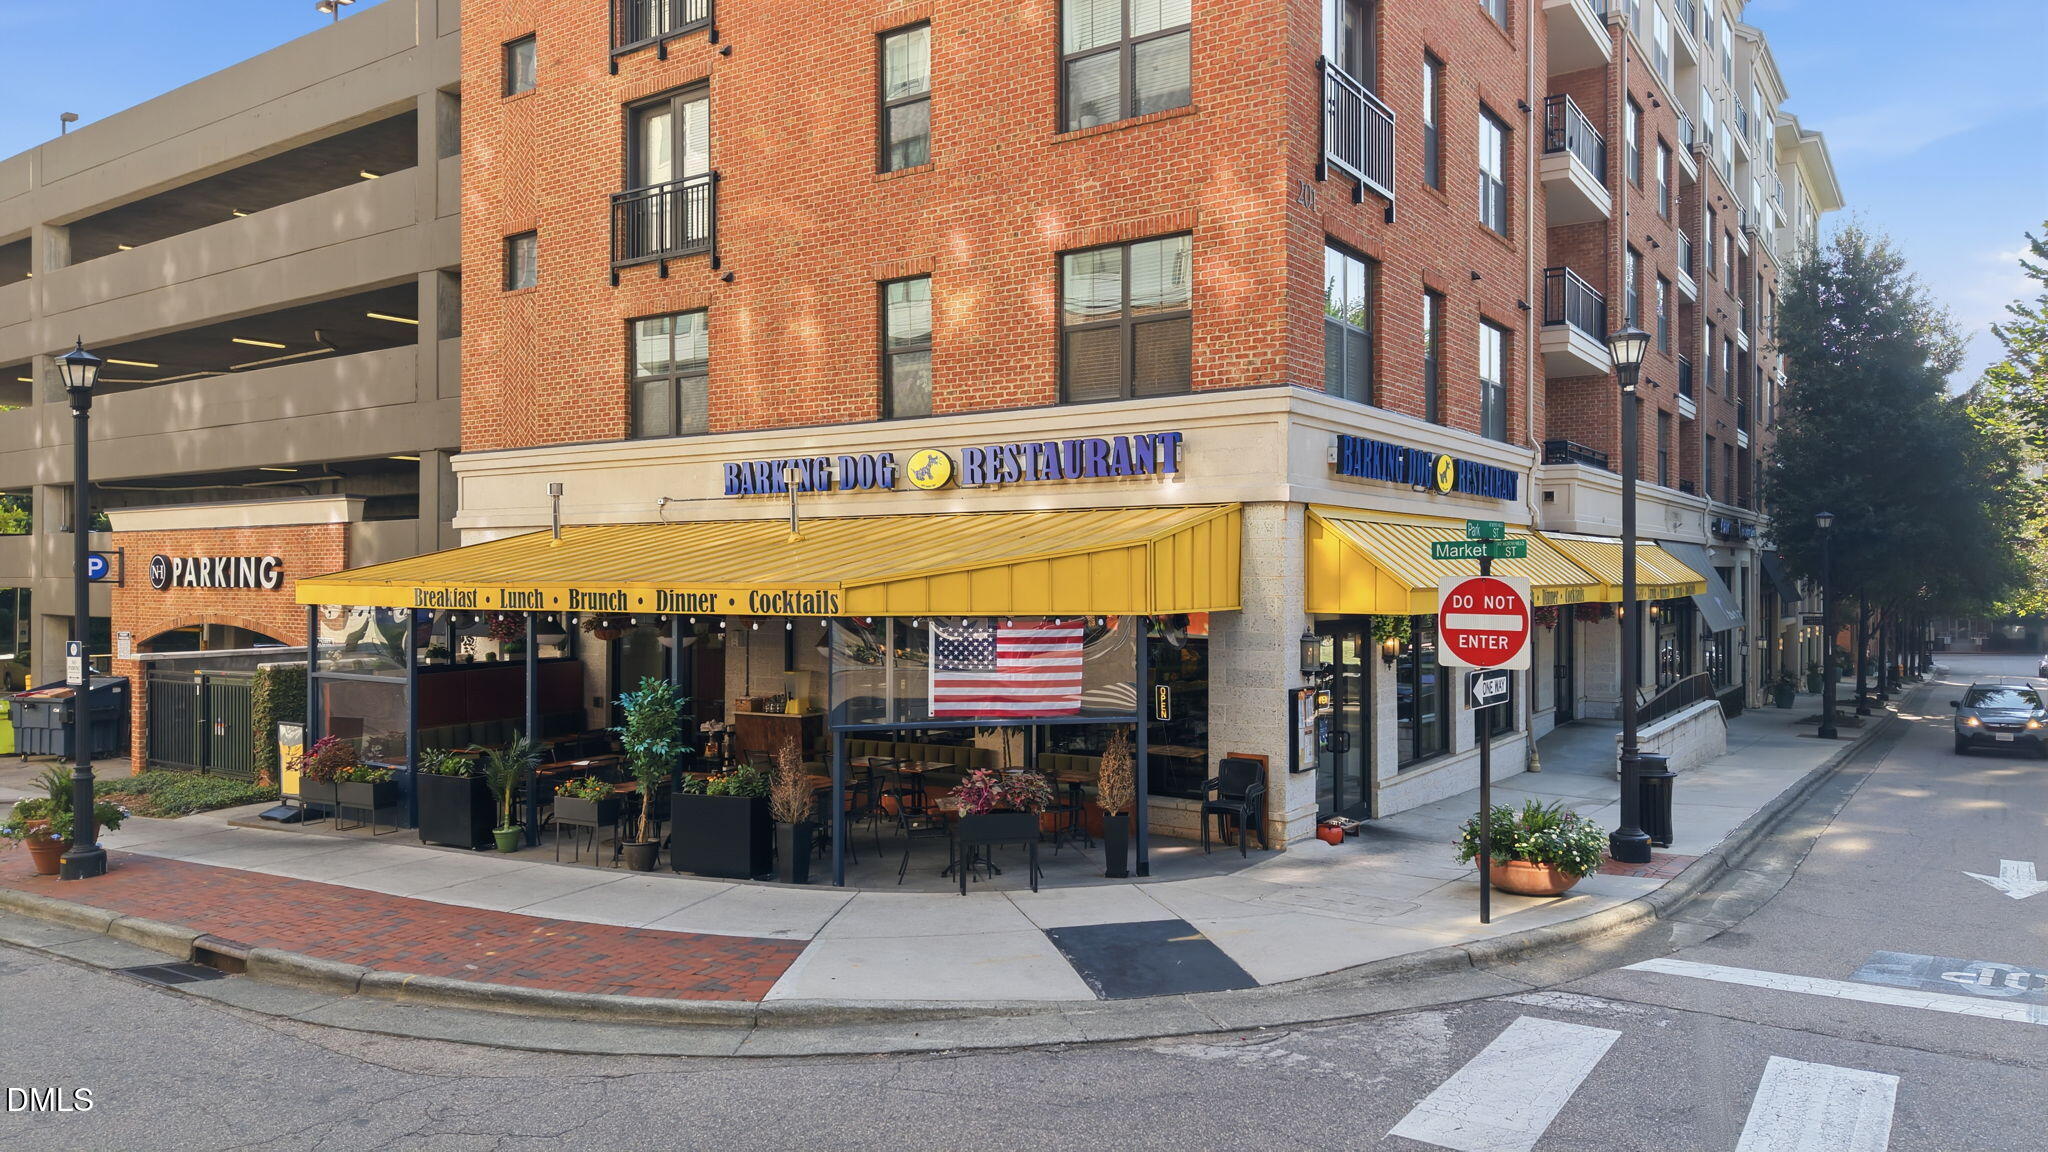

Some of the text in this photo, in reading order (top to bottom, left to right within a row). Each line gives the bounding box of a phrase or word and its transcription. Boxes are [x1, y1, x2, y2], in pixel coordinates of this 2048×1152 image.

[1296, 179, 1316, 212] 201
[838, 452, 896, 490] DOG
[961, 432, 1183, 485] RESTAURANT
[1408, 448, 1433, 488] DOG
[1467, 522, 1500, 538] Park ST
[1436, 543, 1517, 557] Market ST
[88, 558, 103, 576] P
[172, 556, 282, 589] PARKING
[414, 587, 839, 614] Breakfast Lunch Brunch Dinner Cocktails
[1453, 595, 1515, 610] DO NOT
[1459, 634, 1509, 650] ENTER
[1482, 679, 1505, 695] ONE WAY
[1160, 687, 1168, 719] OPEN
